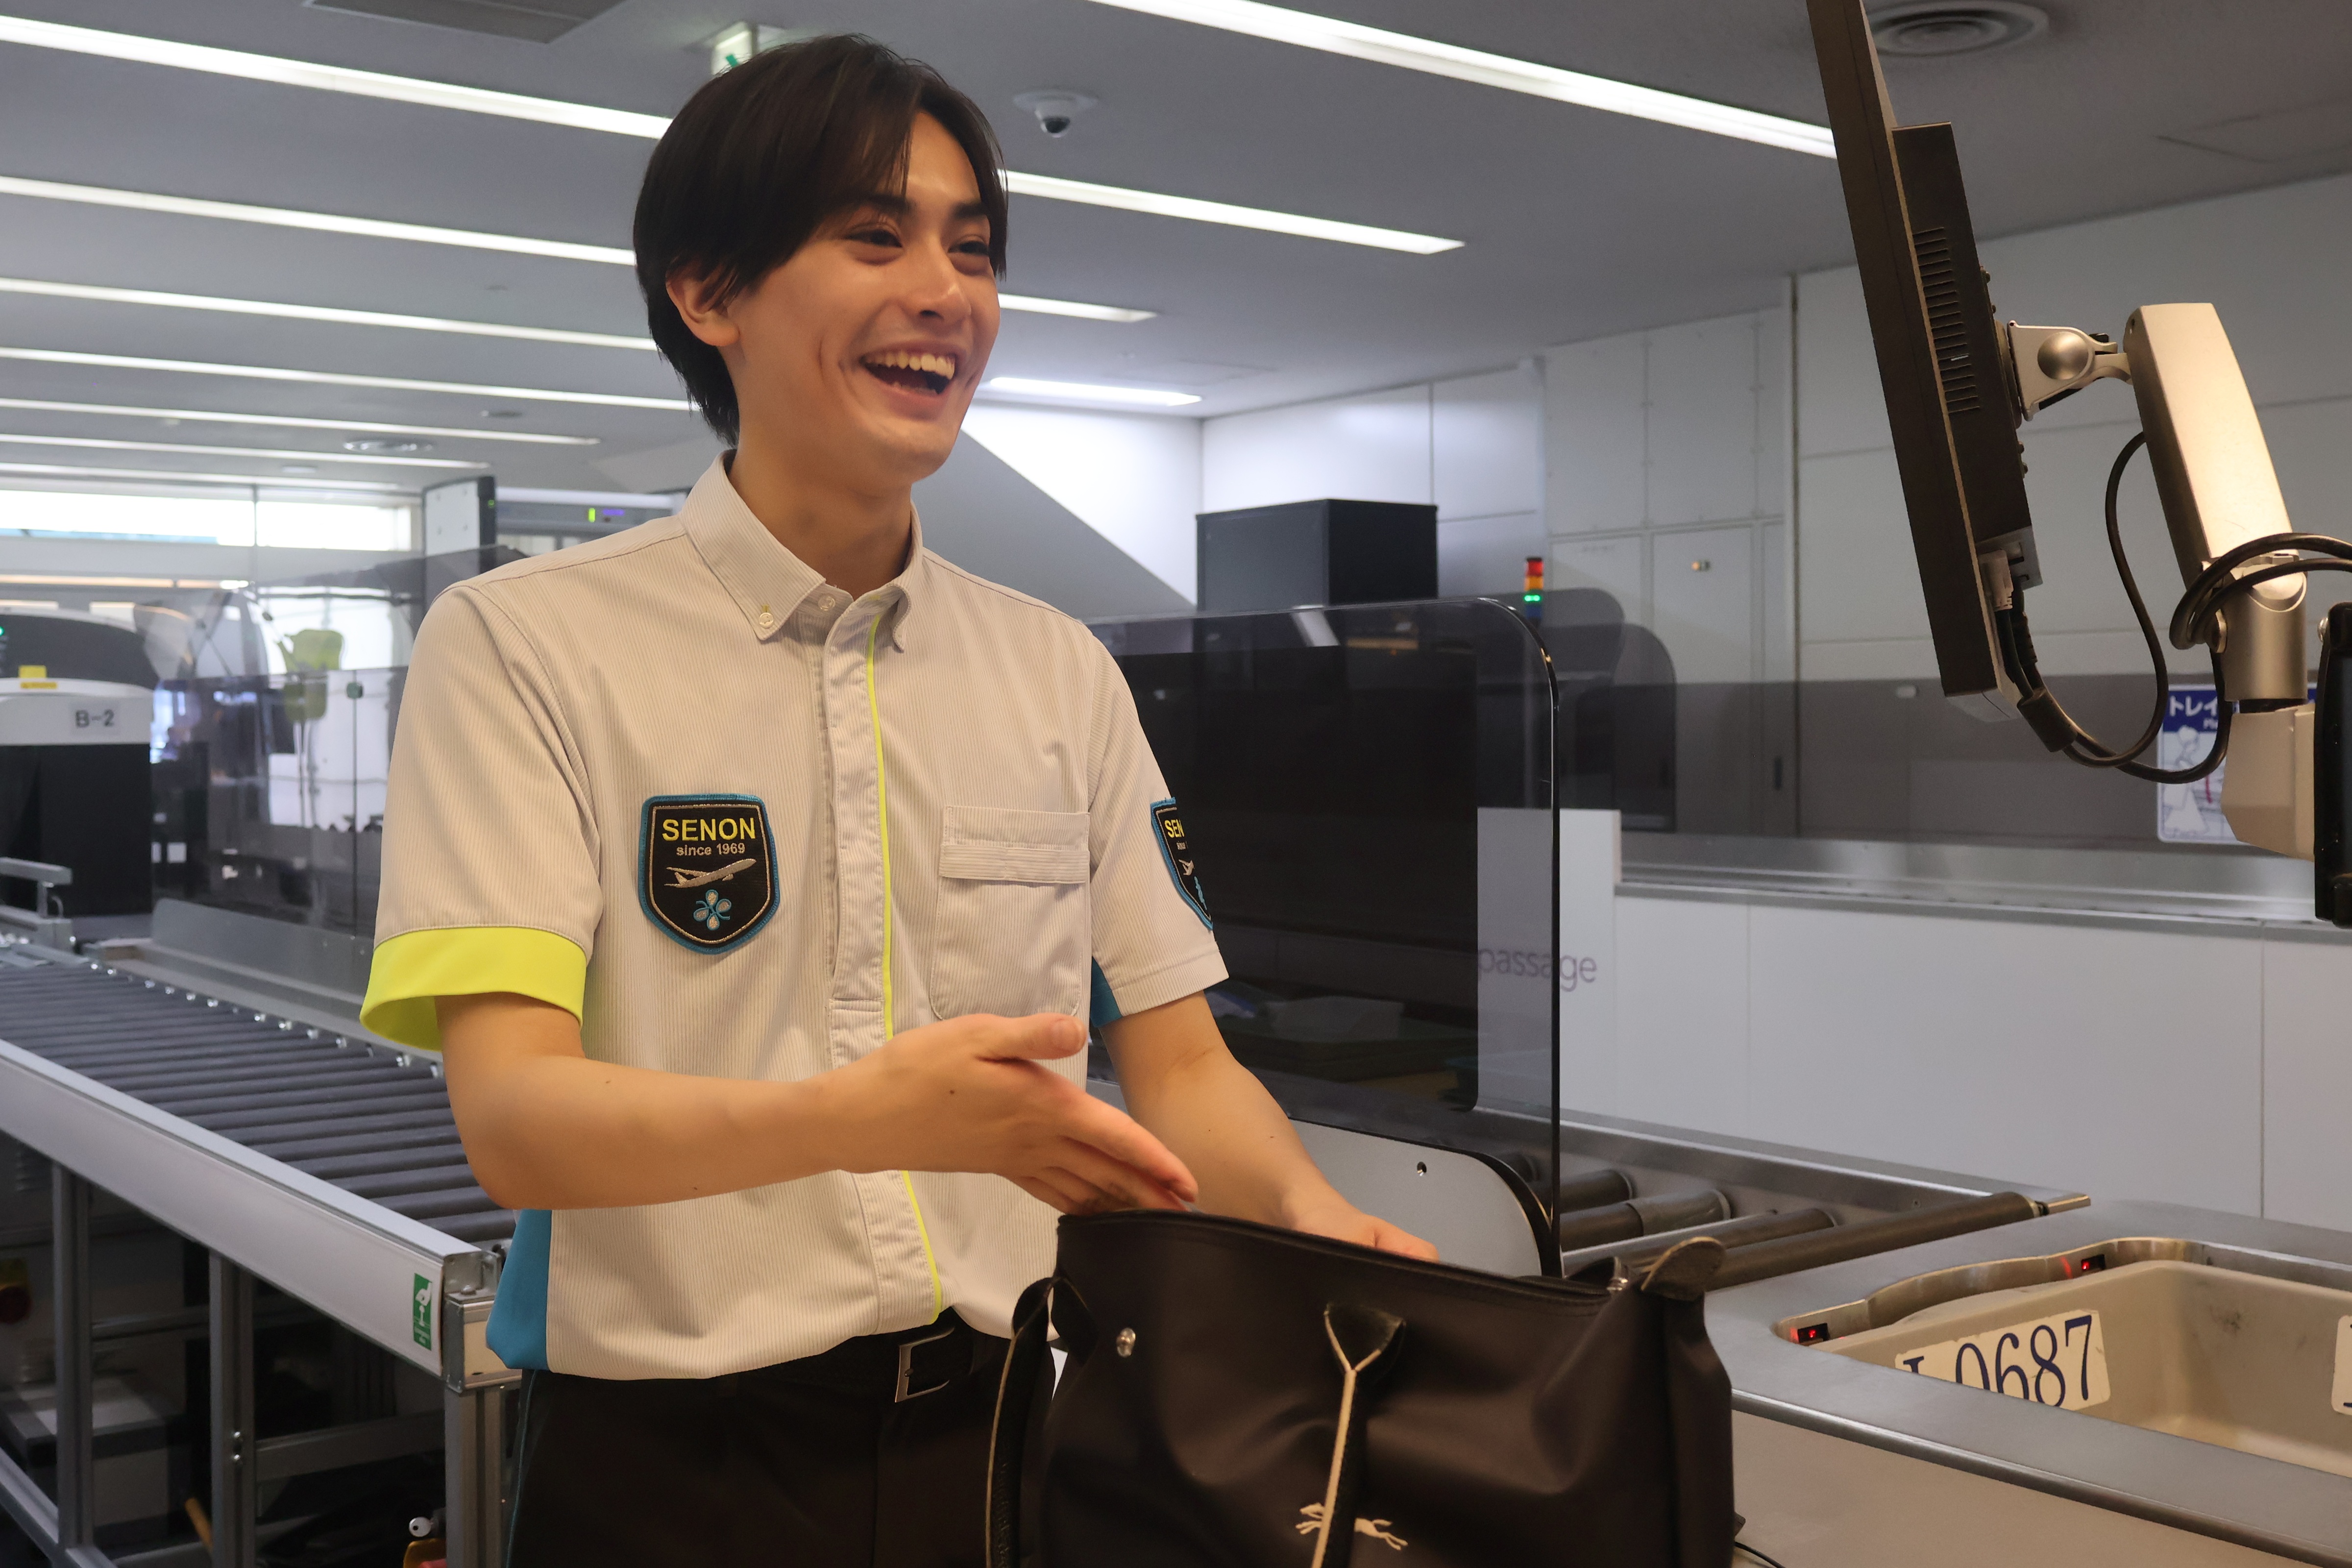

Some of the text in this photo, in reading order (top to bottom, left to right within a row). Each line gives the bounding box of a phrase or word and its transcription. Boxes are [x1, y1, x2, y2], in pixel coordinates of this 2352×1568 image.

[75, 709, 114, 727] B-2
[662, 818, 755, 841] SENON
[677, 843, 745, 856] since 1969
[1478, 948, 1597, 992] passage
[1903, 1314, 2091, 1407] 0687
